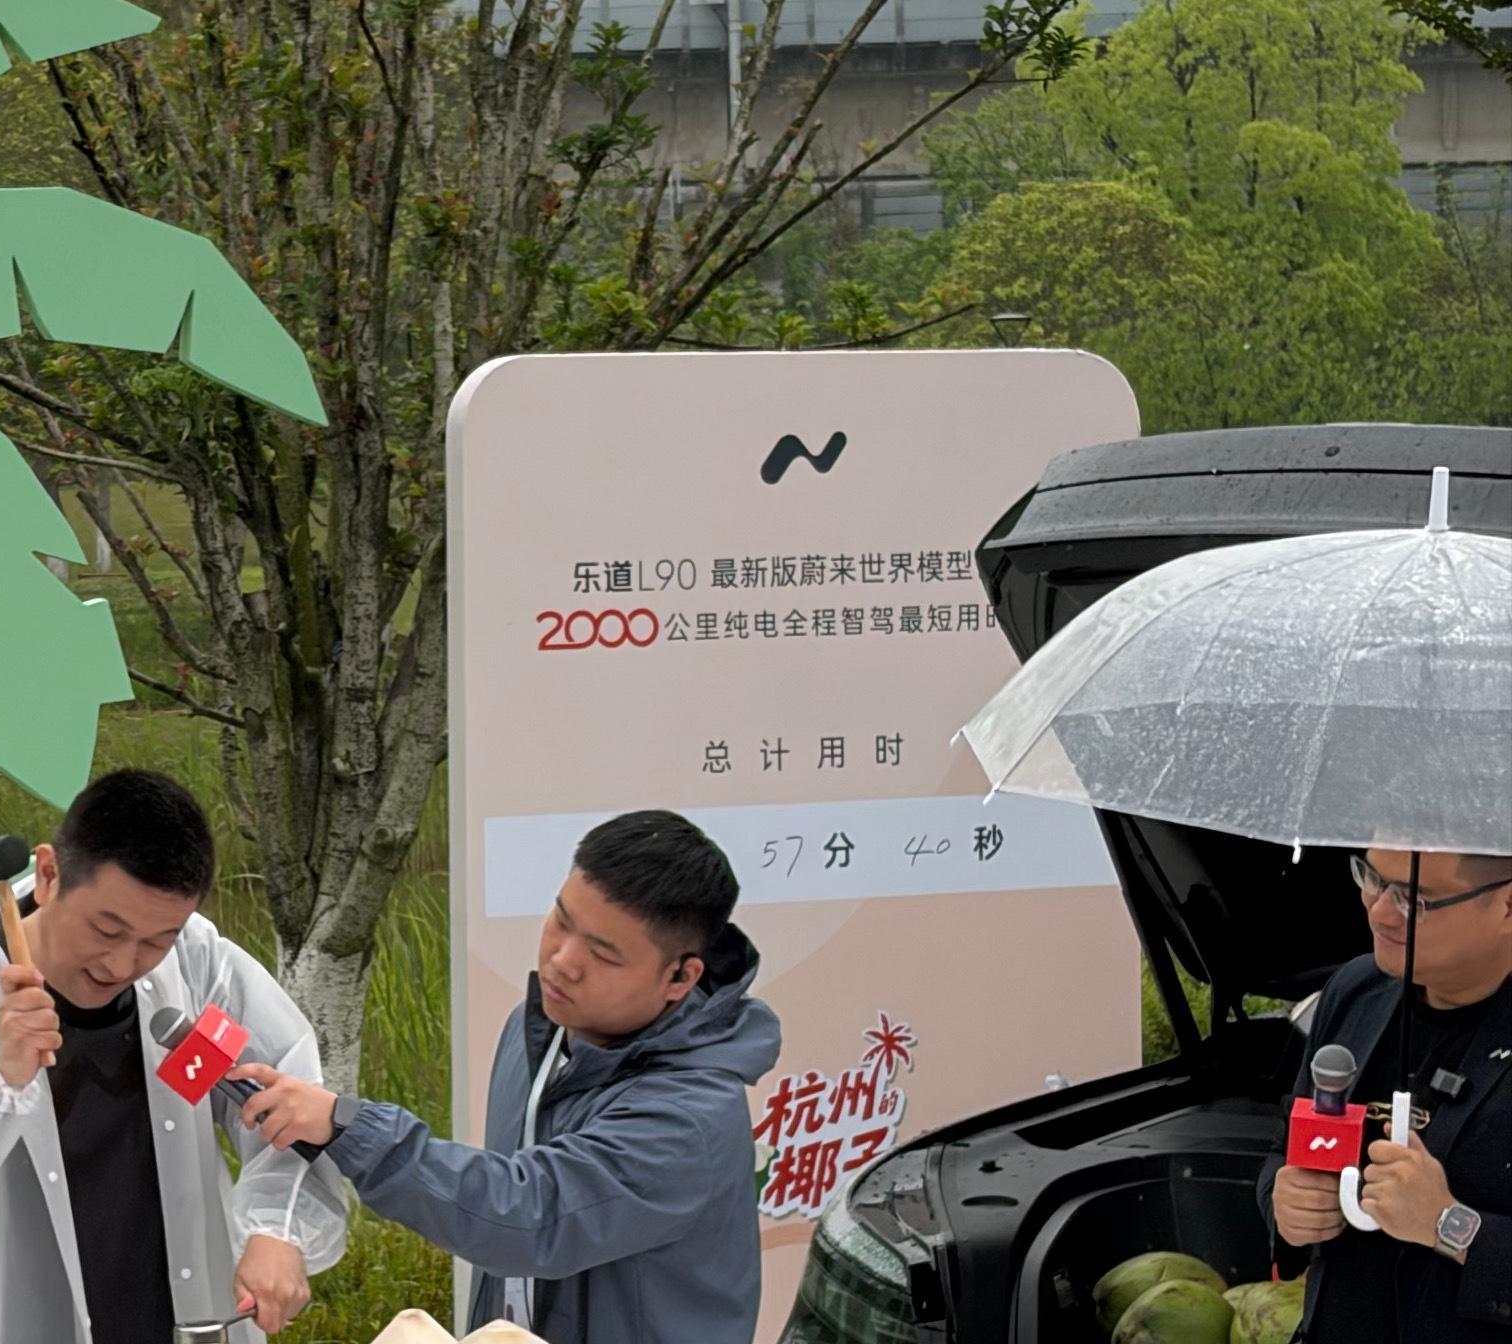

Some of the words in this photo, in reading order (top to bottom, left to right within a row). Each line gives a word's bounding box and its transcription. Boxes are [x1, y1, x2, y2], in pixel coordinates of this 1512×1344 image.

[572, 559, 698, 594] 乐道L90
[710, 550, 974, 590] 最新版蔚来世界模型
[702, 732, 904, 773] 总计用时
[752, 1070, 899, 1147] 杭州的
